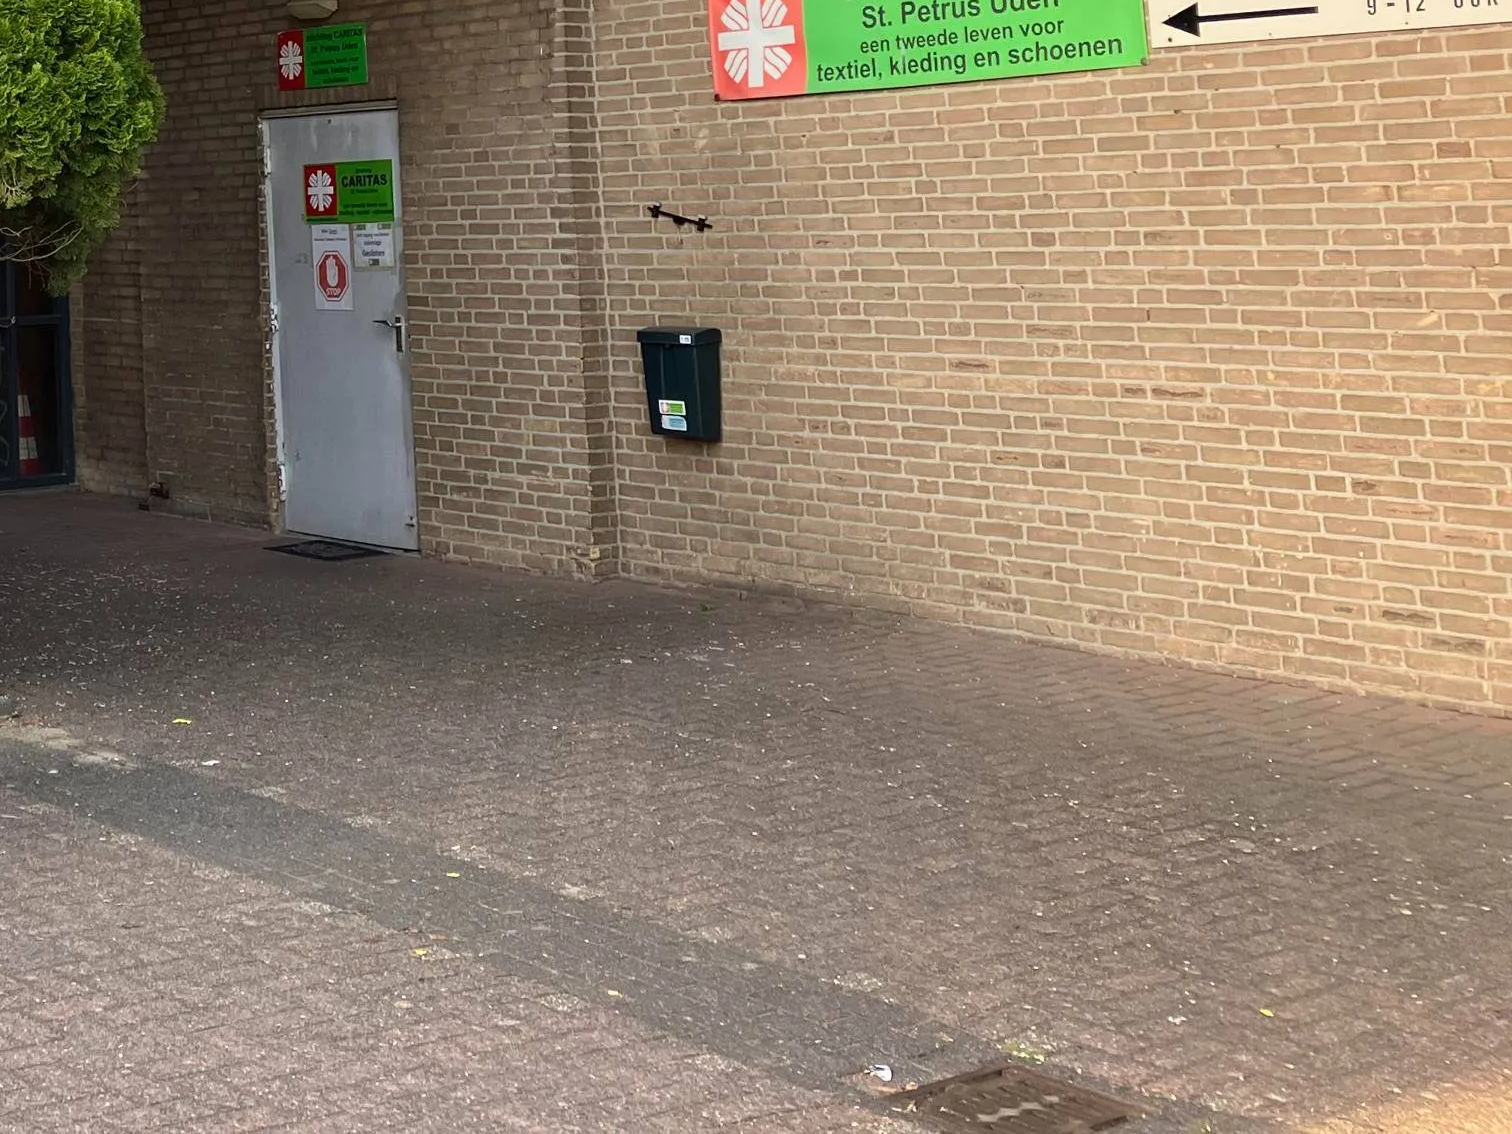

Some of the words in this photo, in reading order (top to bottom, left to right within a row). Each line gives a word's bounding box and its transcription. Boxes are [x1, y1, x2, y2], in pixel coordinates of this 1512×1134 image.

[862, 4, 892, 29] St.
[860, 37, 890, 54] een
[896, 29, 959, 50] tweede
[964, 25, 1014, 44] leven
[1019, 19, 1065, 37] voor
[817, 57, 882, 82] textiel,
[890, 50, 967, 75] kleding
[974, 50, 1001, 68] en
[1008, 37, 1123, 65] schoenen
[341, 174, 388, 187] CARITAS
